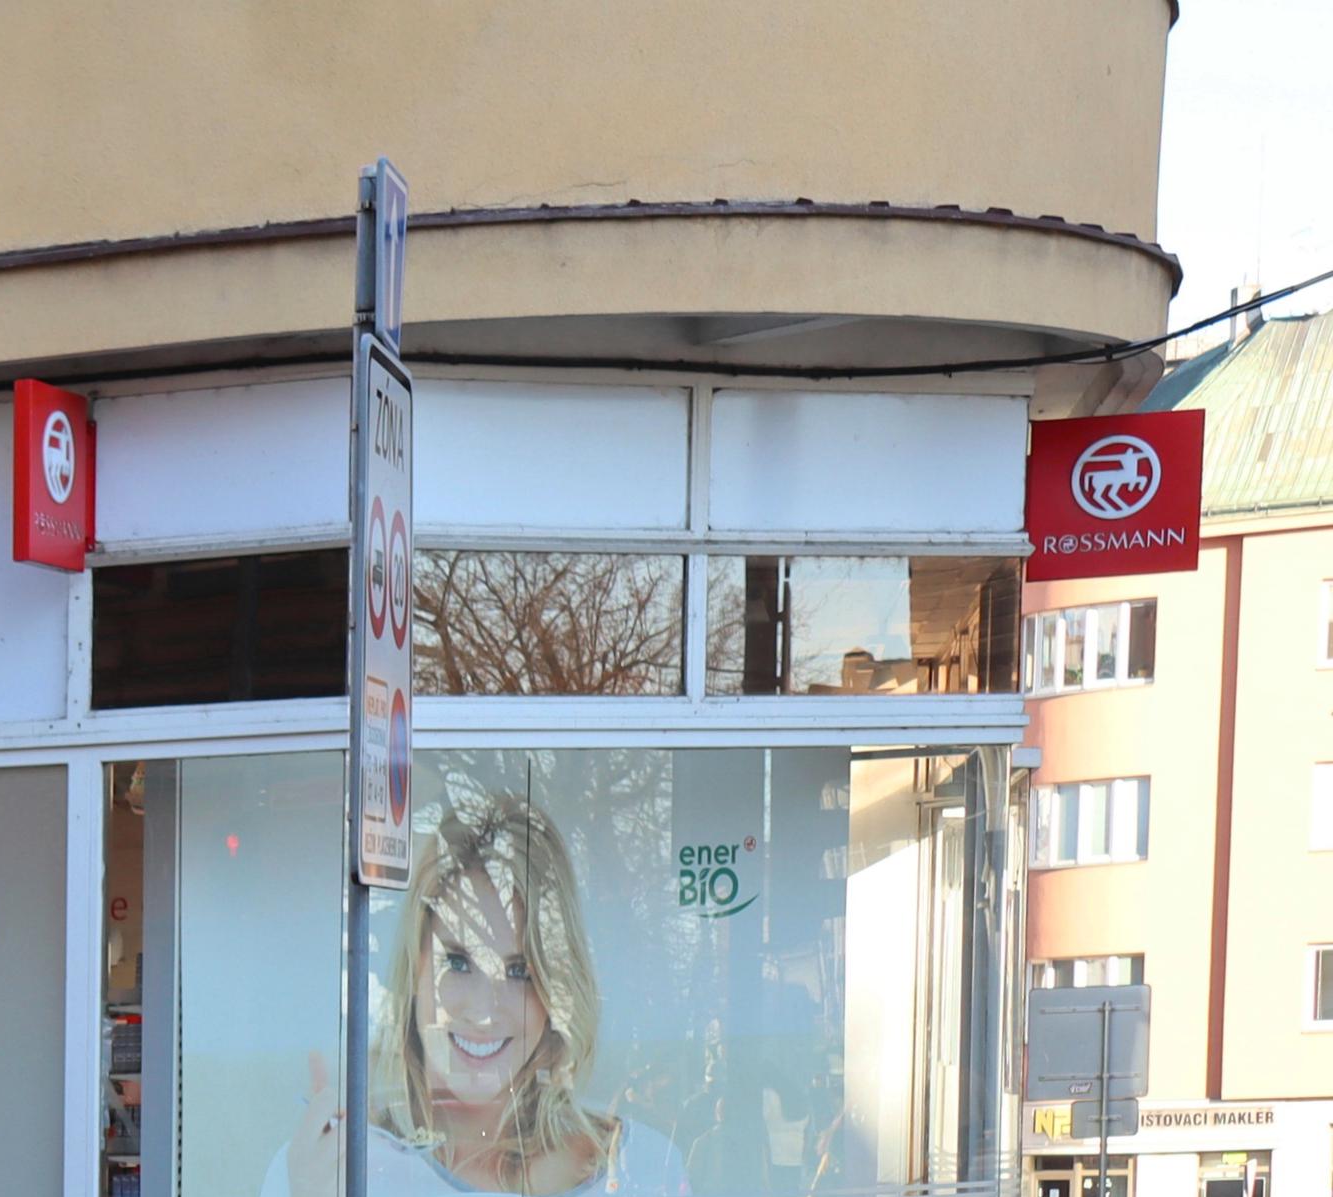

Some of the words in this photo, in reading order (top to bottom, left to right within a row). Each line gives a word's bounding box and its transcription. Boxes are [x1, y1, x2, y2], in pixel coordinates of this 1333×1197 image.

[375, 377, 405, 472] ZÓNA
[1043, 527, 1186, 556] ROSSMANN
[679, 843, 740, 866] ener
[1140, 1109, 1208, 1127] IŠŤOVACÍ
